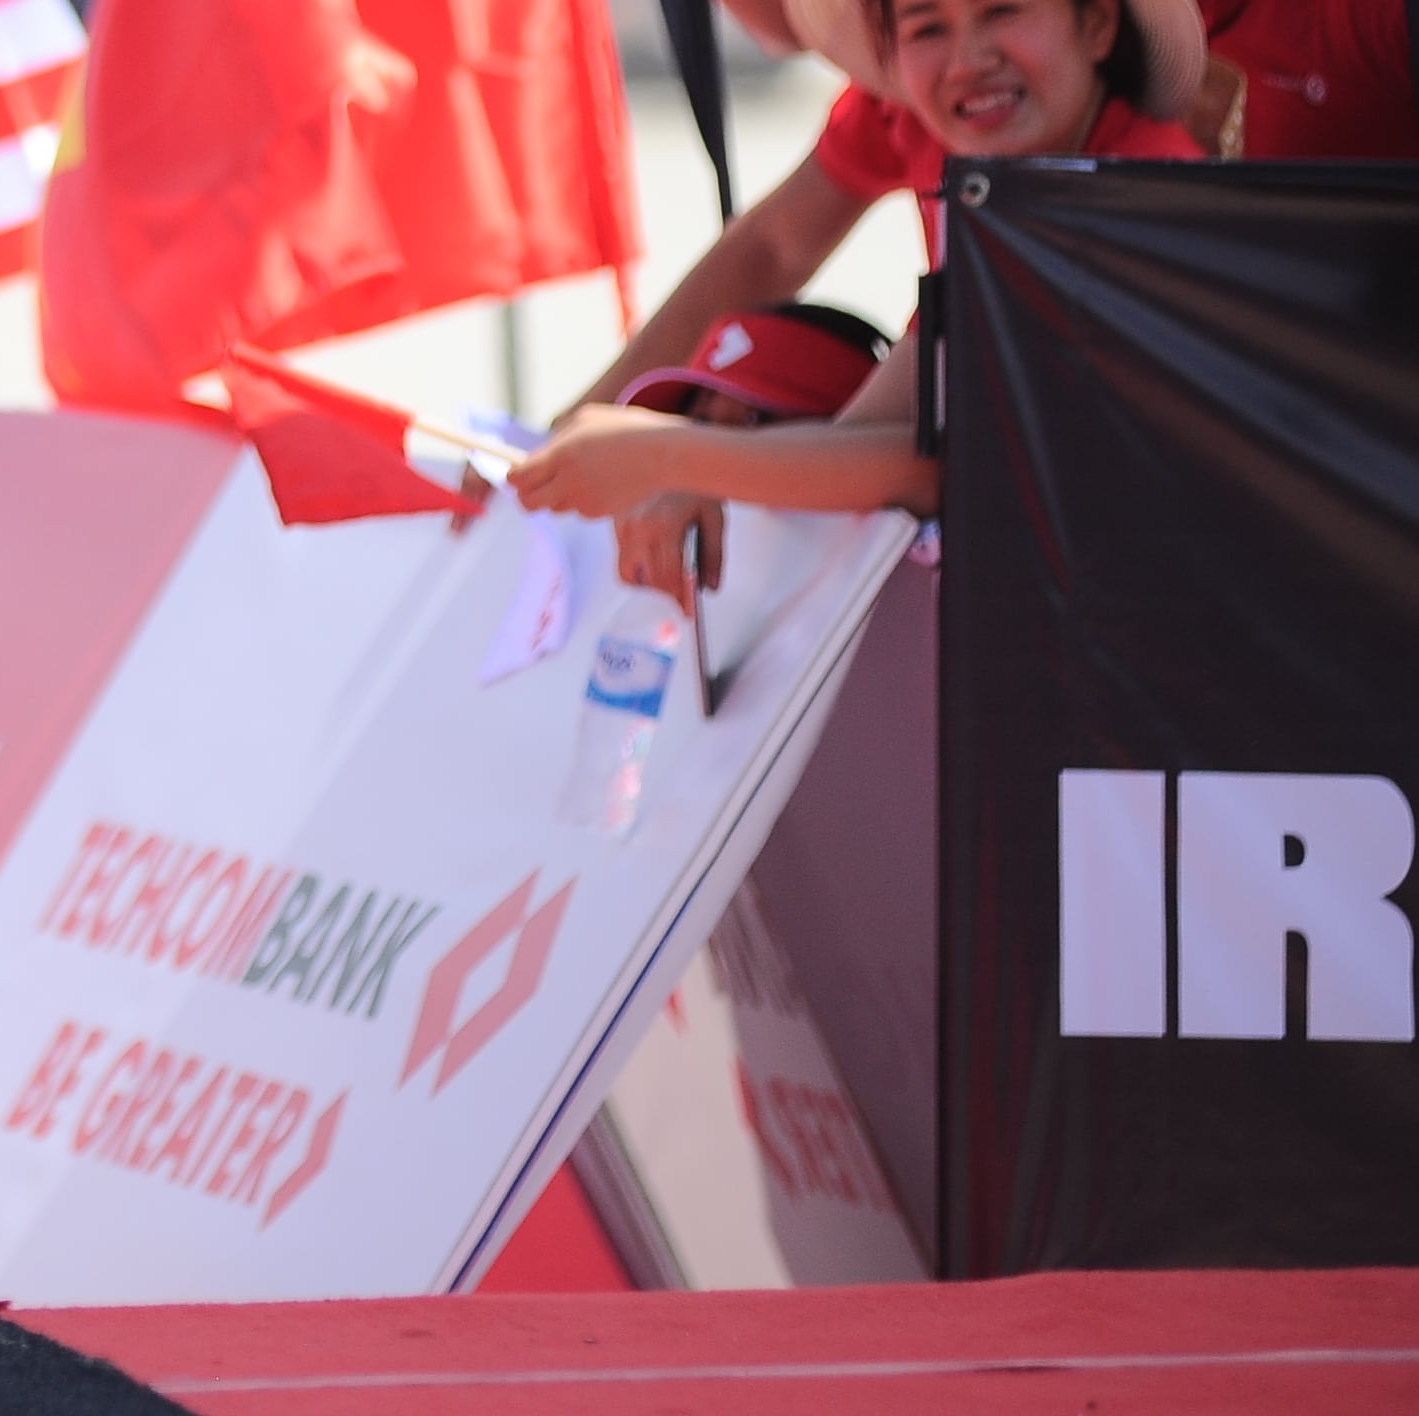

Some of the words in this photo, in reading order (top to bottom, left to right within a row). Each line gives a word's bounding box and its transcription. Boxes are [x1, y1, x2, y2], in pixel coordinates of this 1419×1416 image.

[37, 821, 441, 1021] TECHCOMBANK
[1059, 767, 1415, 1042] IR
[5, 1021, 105, 1138] BE
[72, 1039, 311, 1207] GREATER
